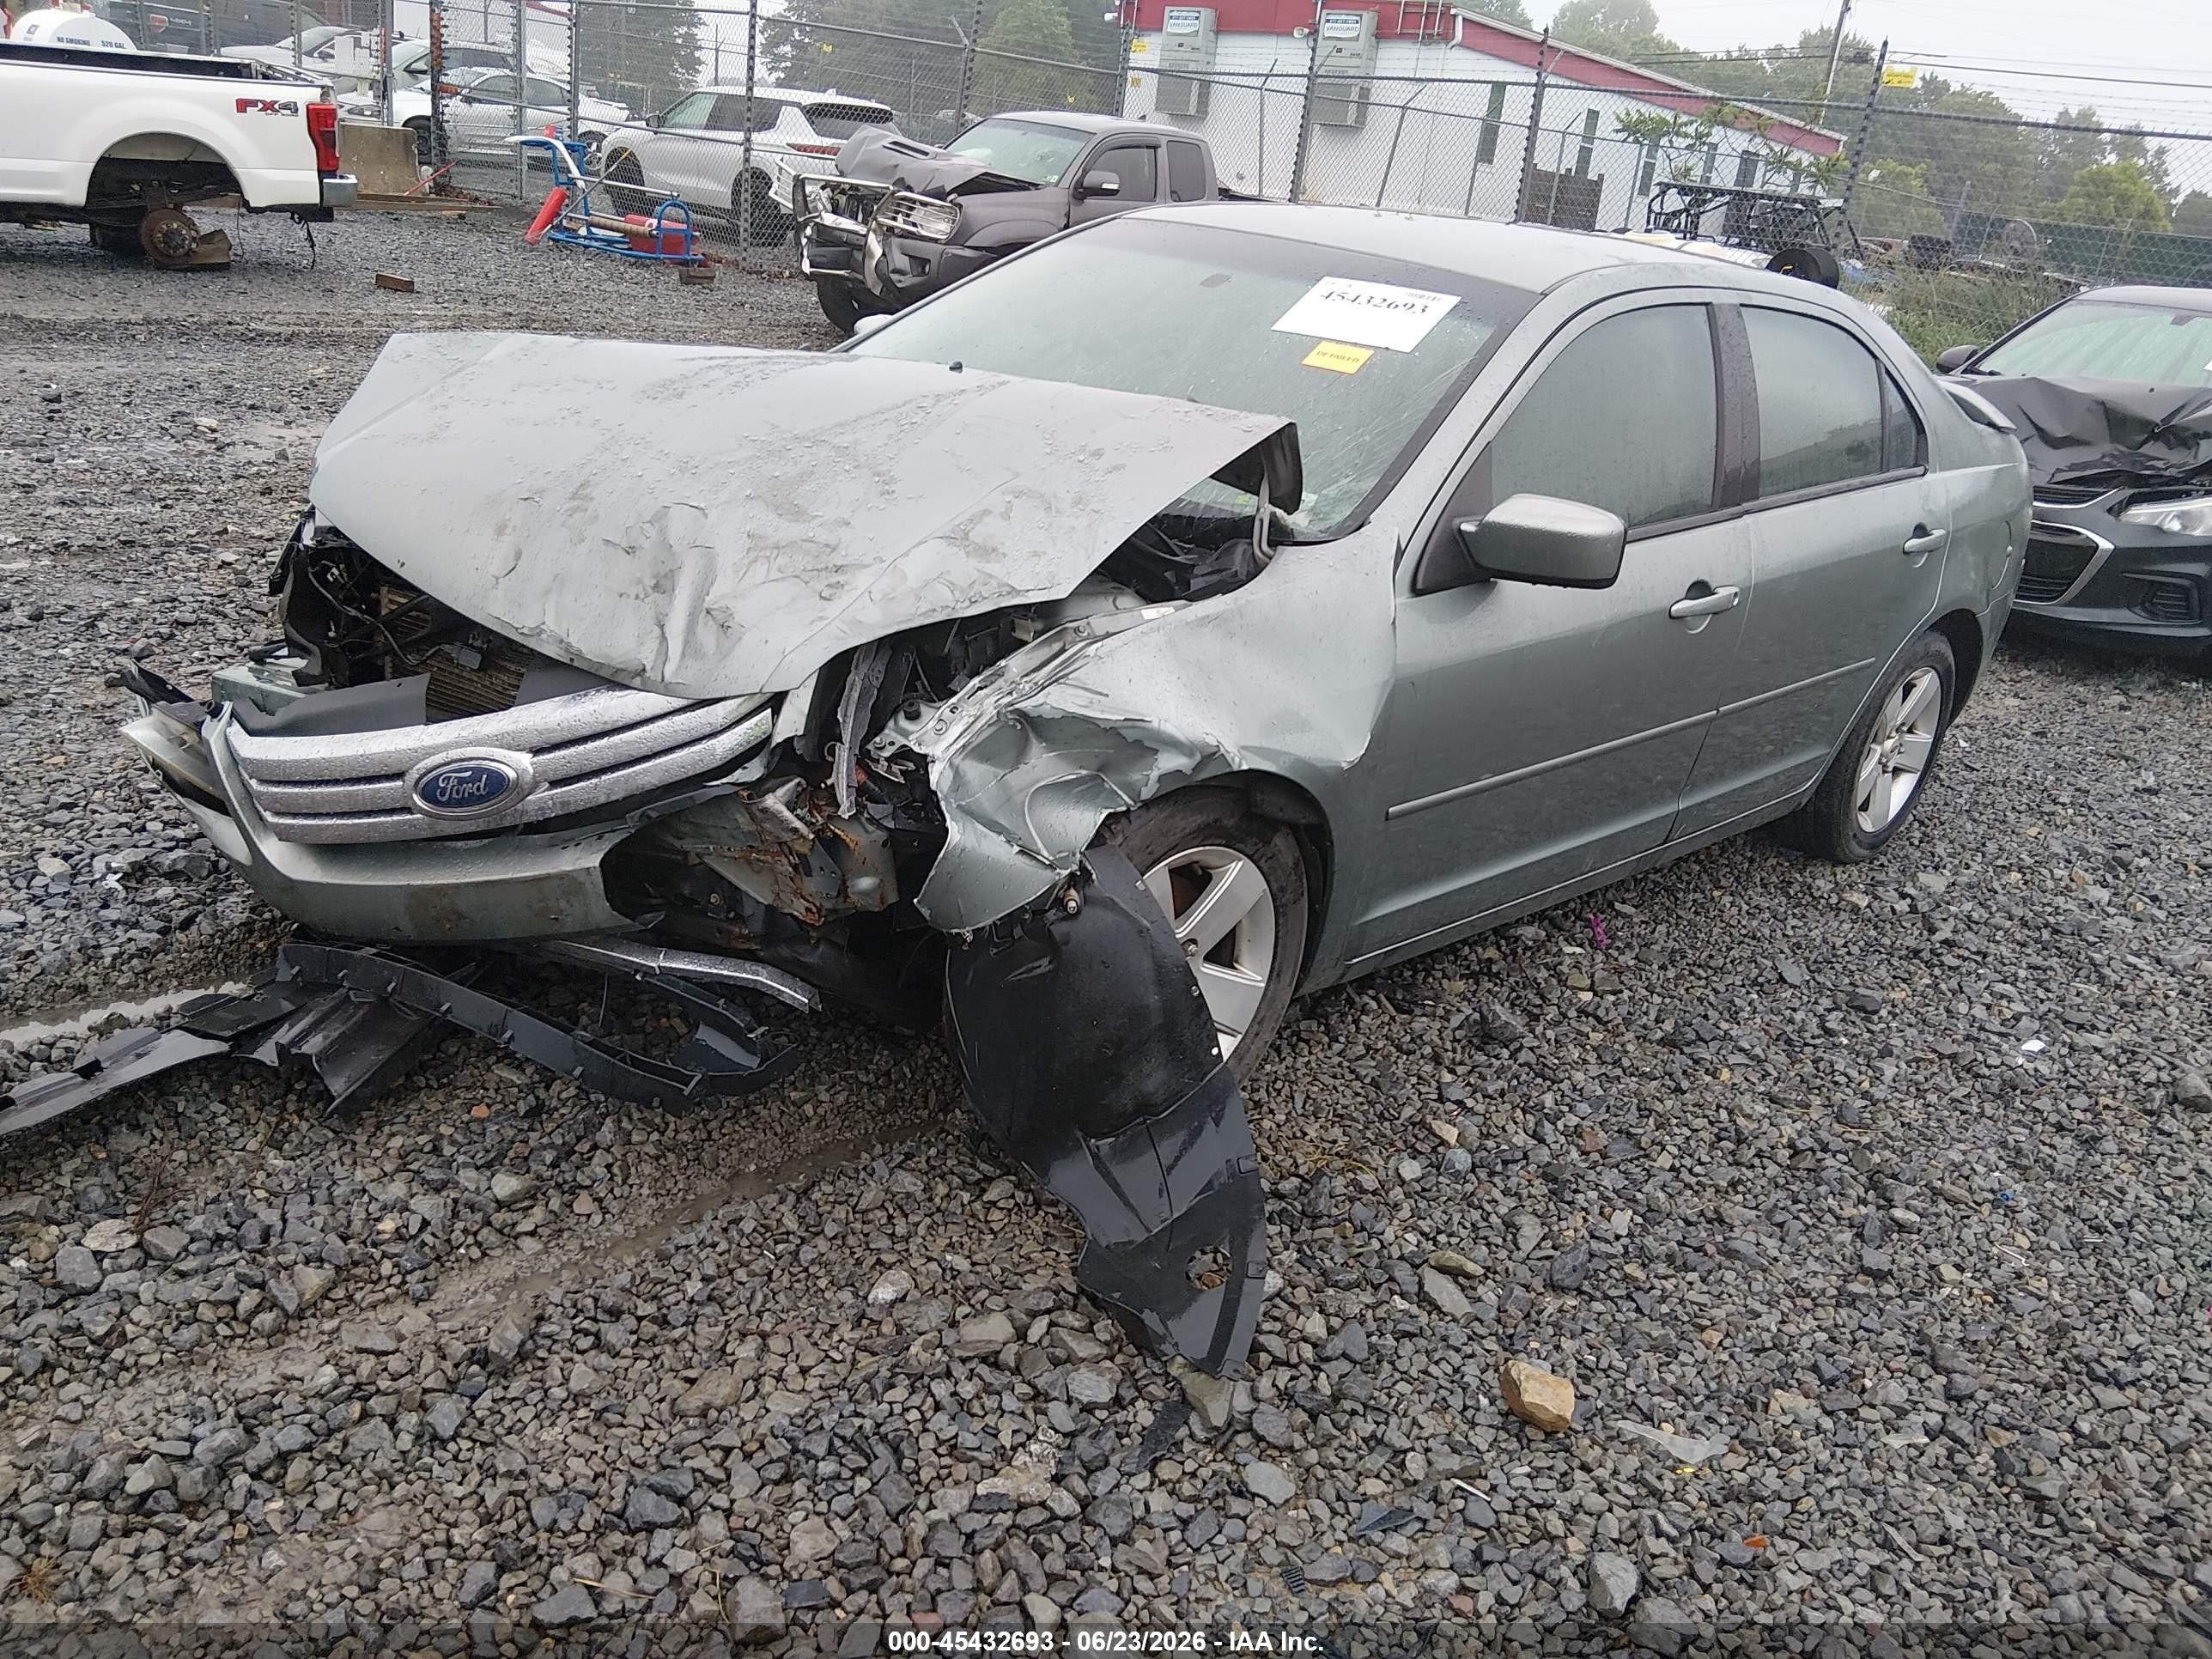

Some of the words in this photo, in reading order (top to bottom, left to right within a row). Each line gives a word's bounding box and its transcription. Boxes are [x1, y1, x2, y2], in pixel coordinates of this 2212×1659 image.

[65, 37, 90, 46] SMOKING
[236, 99, 299, 113] FX4
[1320, 290, 1429, 314] 45432693
[436, 770, 489, 802] Ford
